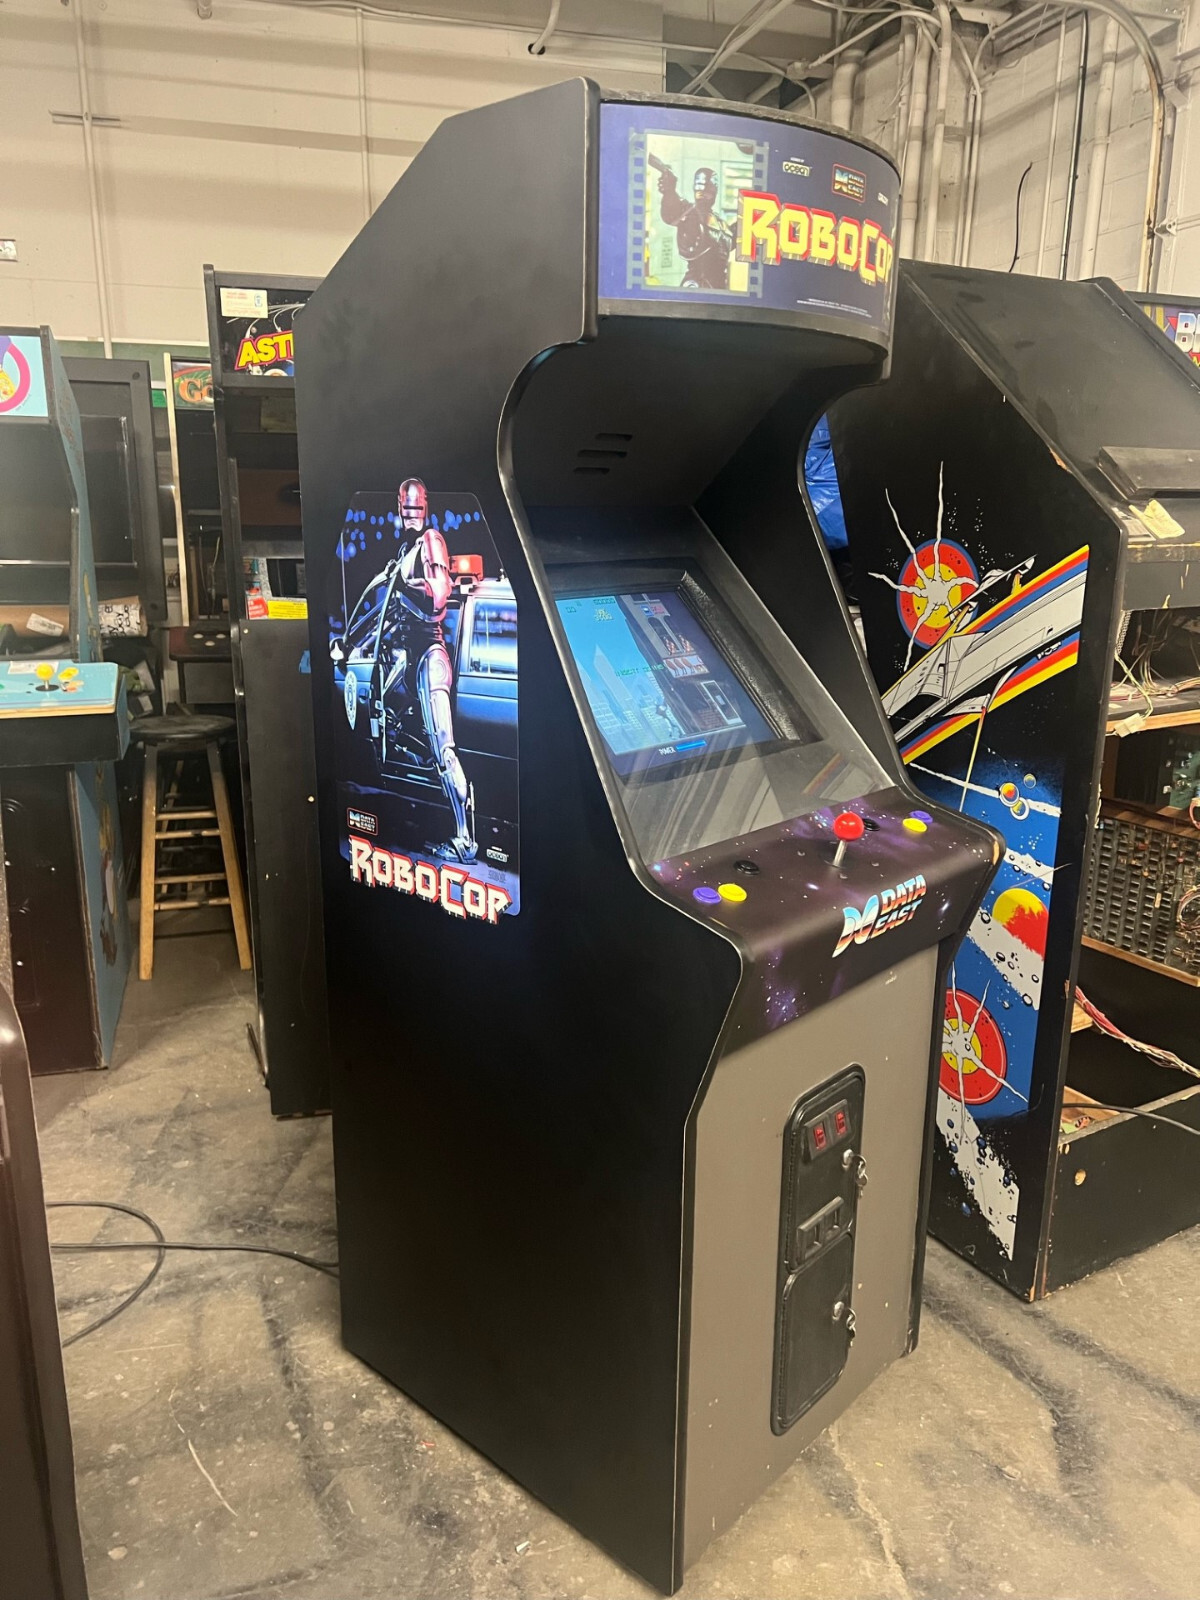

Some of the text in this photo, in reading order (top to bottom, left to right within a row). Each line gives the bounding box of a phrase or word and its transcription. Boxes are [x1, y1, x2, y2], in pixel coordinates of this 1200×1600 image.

[235, 330, 294, 370] AST
[349, 835, 513, 925] ROBOCOP
[880, 875, 926, 915] DATA
[871, 899, 922, 939] EAST
